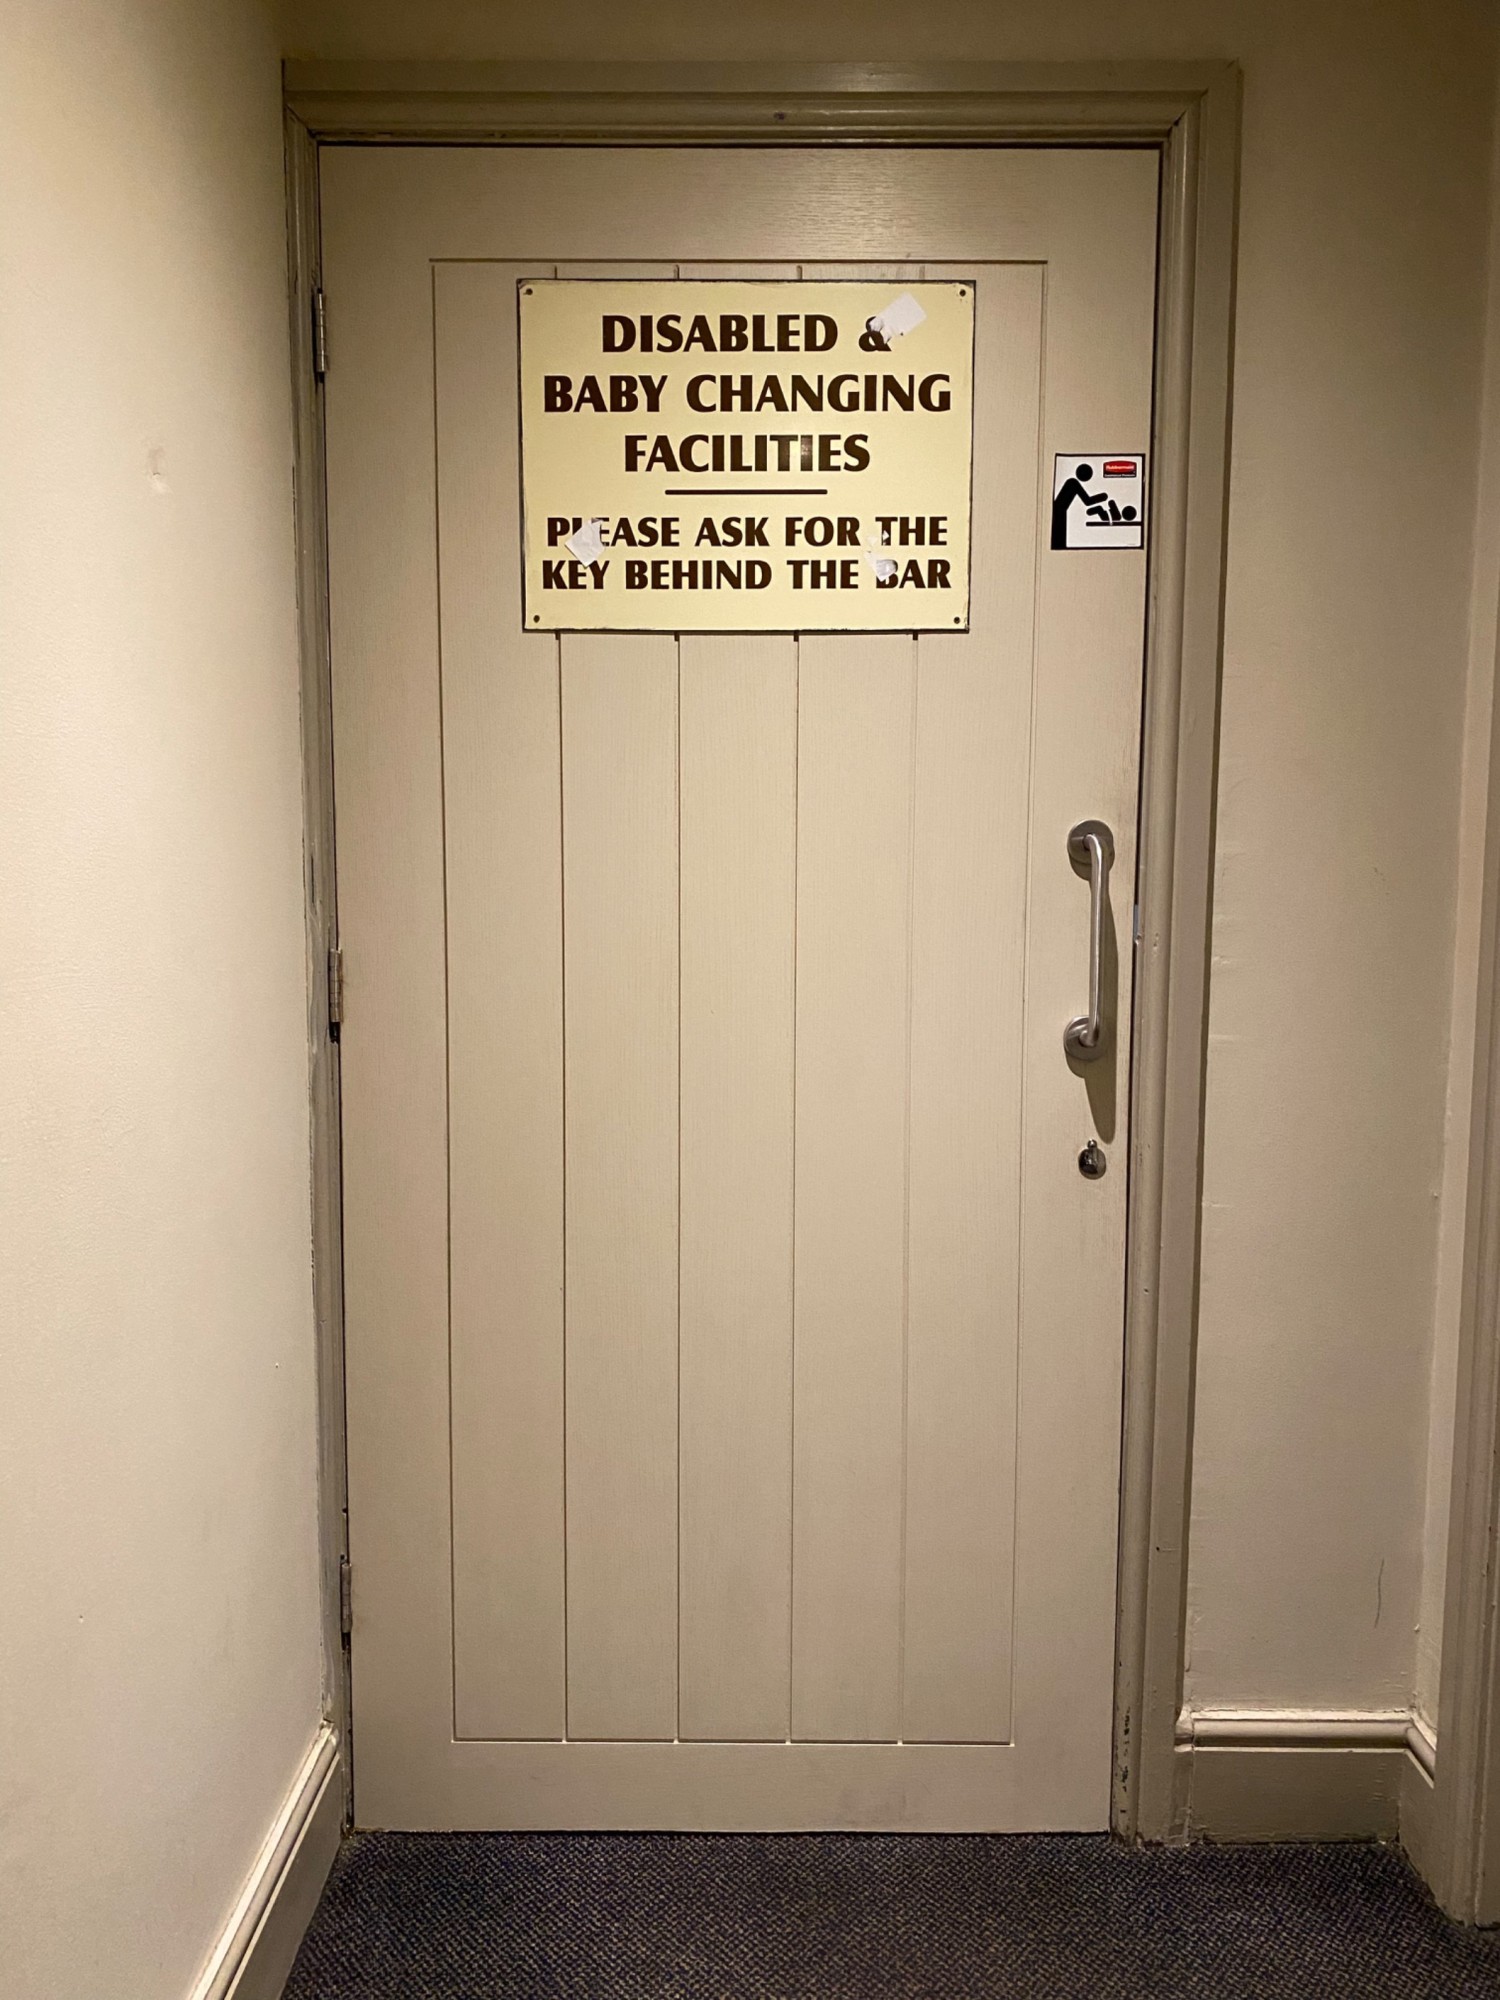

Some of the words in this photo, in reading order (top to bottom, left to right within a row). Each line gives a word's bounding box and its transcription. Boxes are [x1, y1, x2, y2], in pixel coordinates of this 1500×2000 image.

[603, 315, 837, 352] DISABLED
[859, 316, 892, 352] &
[544, 375, 667, 412] BABY
[687, 374, 951, 412] CHANGING
[625, 434, 870, 472] FACILITIES
[695, 517, 769, 547] ASK
[786, 517, 860, 547] FOR
[875, 517, 947, 546] THE
[543, 560, 610, 589] KEY
[626, 560, 771, 589] BEHIND
[787, 560, 858, 589] THE
